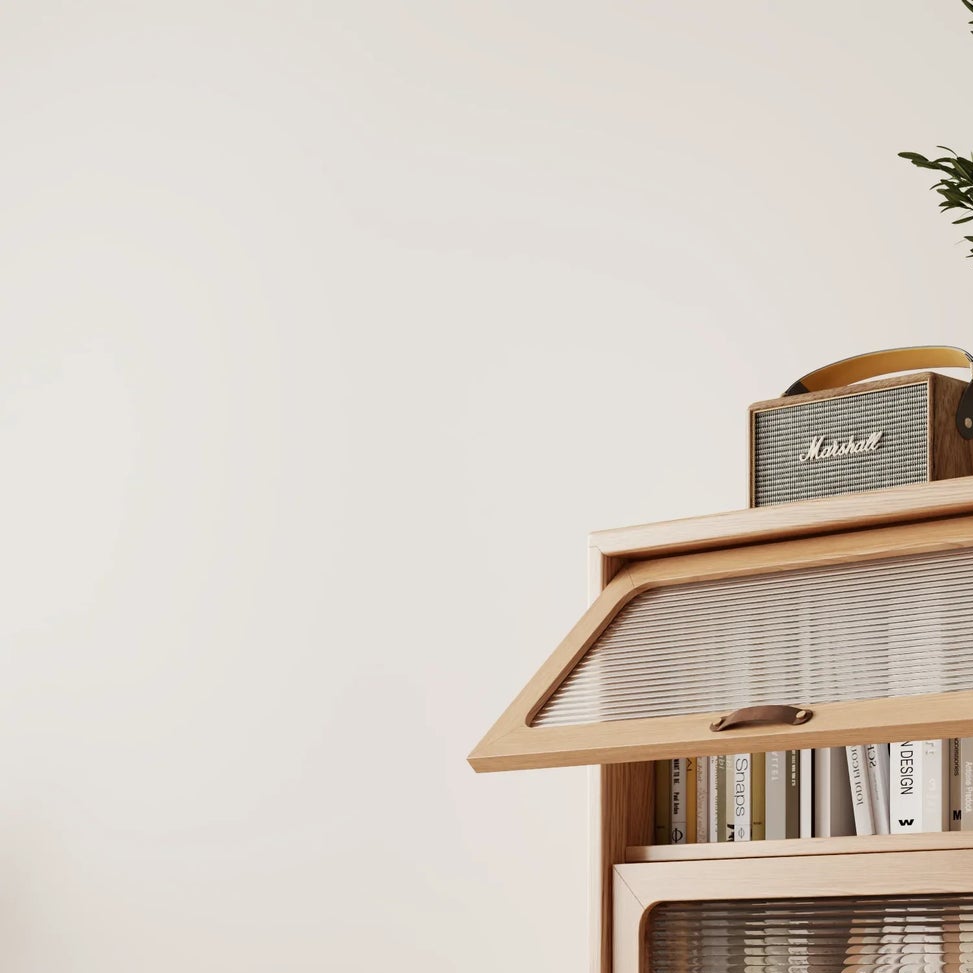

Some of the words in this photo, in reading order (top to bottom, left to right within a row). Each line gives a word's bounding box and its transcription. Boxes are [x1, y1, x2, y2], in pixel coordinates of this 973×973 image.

[799, 431, 884, 462] Marshall
[733, 758, 749, 817] Snaps
[900, 750, 915, 795] DESIGN
[898, 818, 915, 827] W
